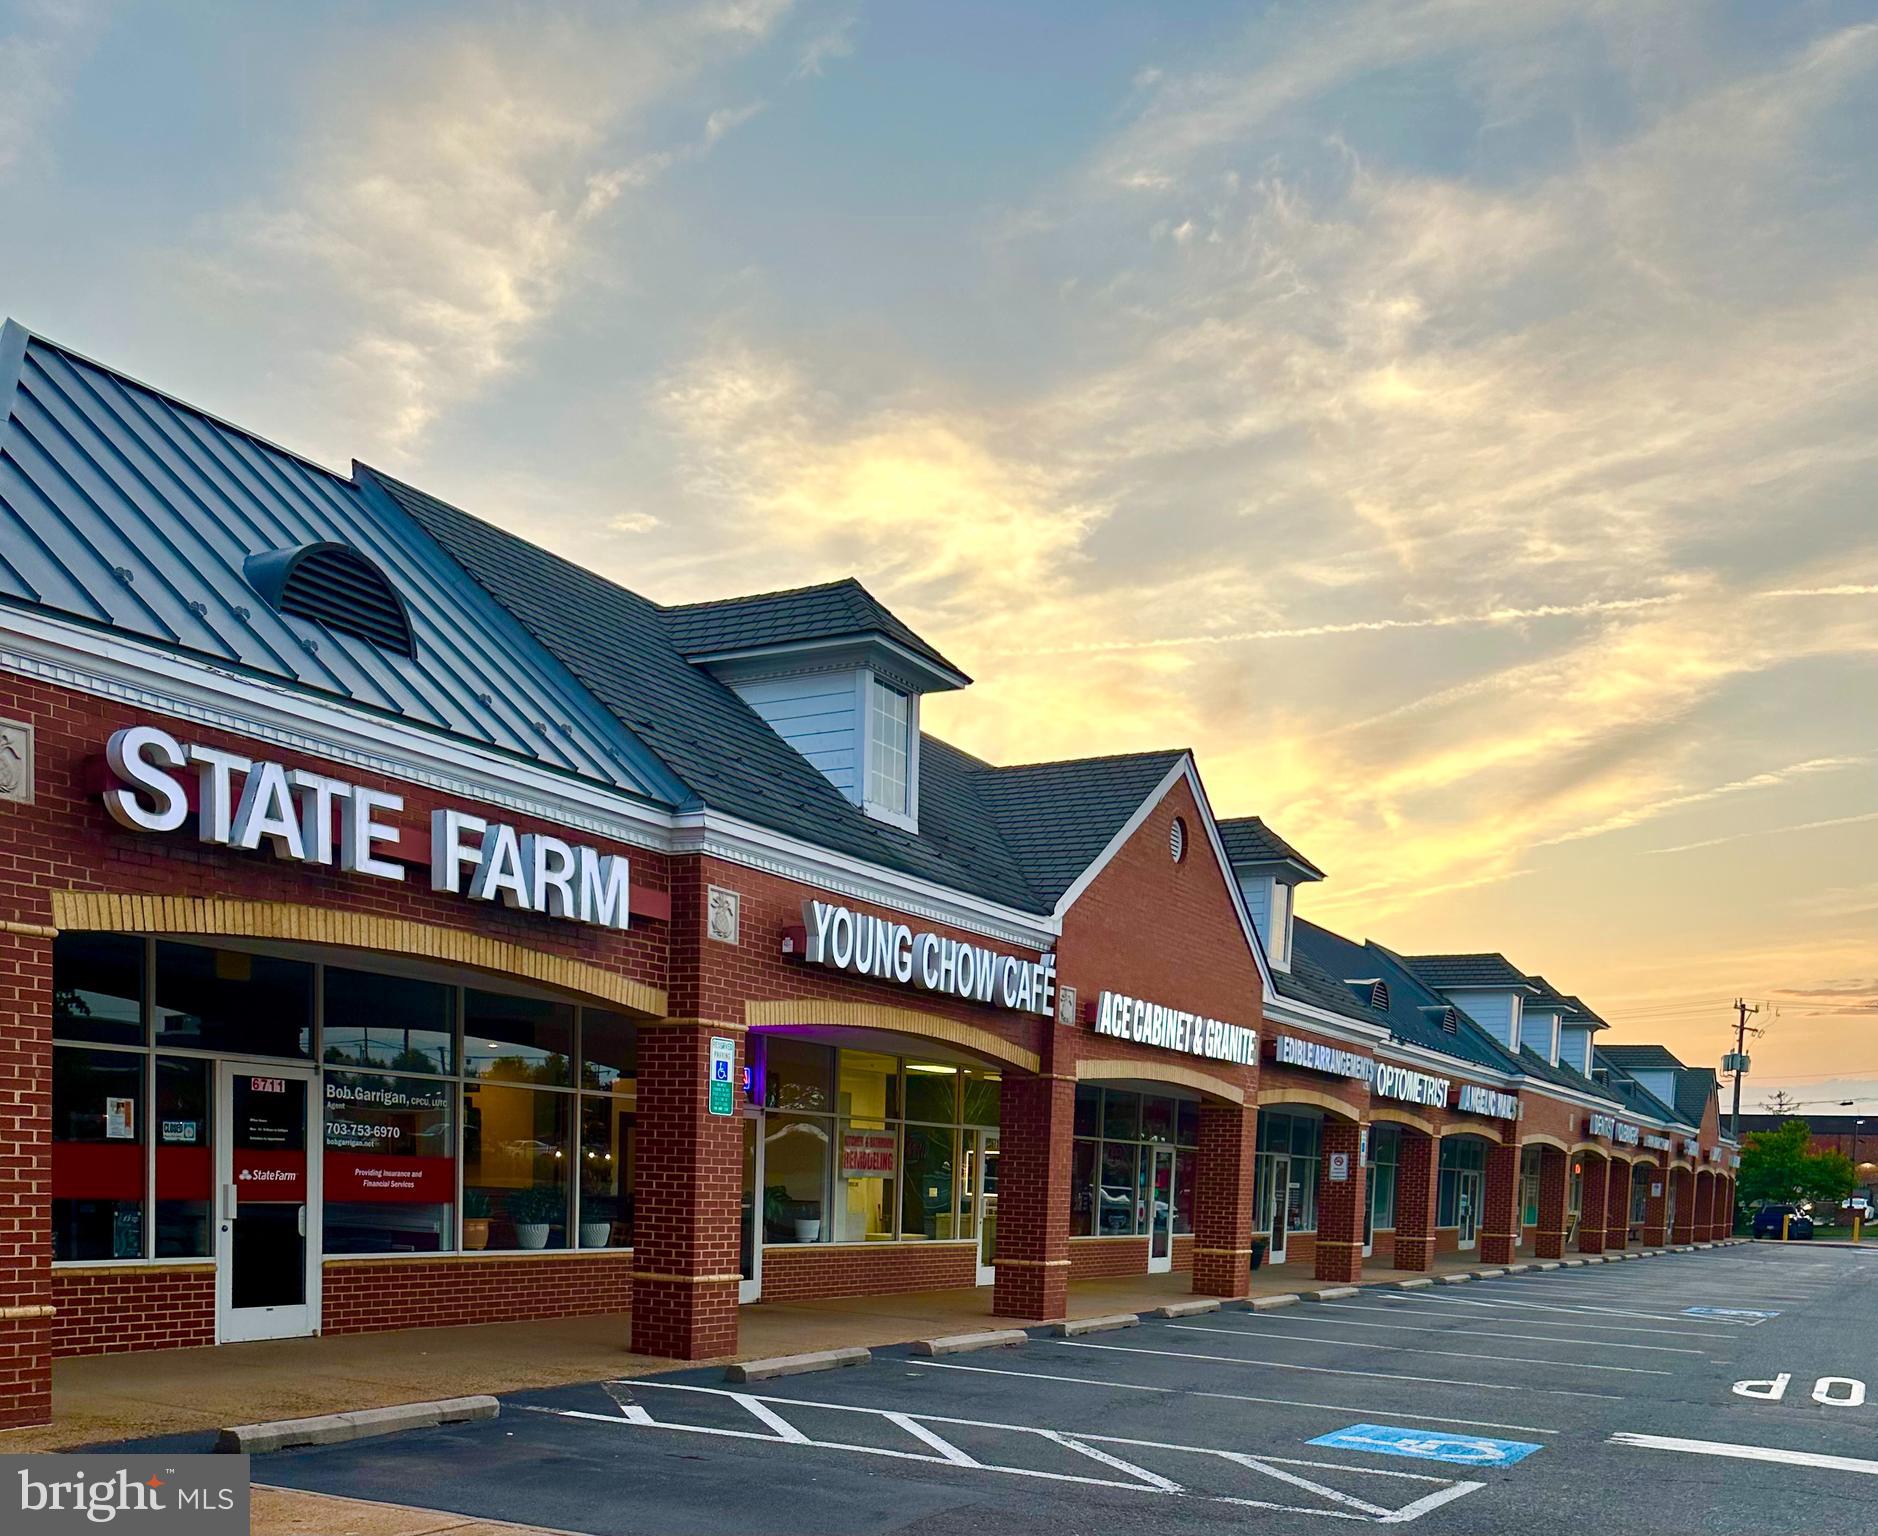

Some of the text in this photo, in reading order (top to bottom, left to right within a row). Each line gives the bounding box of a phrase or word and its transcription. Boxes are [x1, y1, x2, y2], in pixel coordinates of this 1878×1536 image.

[104, 725, 630, 929] STATE FARM
[804, 900, 1056, 1016] YOUNG CHOW CAFÉ
[1097, 991, 1256, 1066] ACE CABINET & GRANITE
[1283, 1036, 1374, 1082] EDIBLE ARRANGEMENTS
[252, 1078, 284, 1092] 6711
[326, 1084, 351, 1099] Bob
[355, 1087, 410, 1106] Garrigan,
[1376, 1062, 1450, 1108] OPTOMETRIST
[327, 1101, 345, 1110] Agent
[326, 1122, 400, 1139] 703-753-6970
[843, 1151, 893, 1171] REMODELING
[354, 1168, 423, 1179] Providing Insurance and
[363, 1179, 415, 1189] Financial Services
